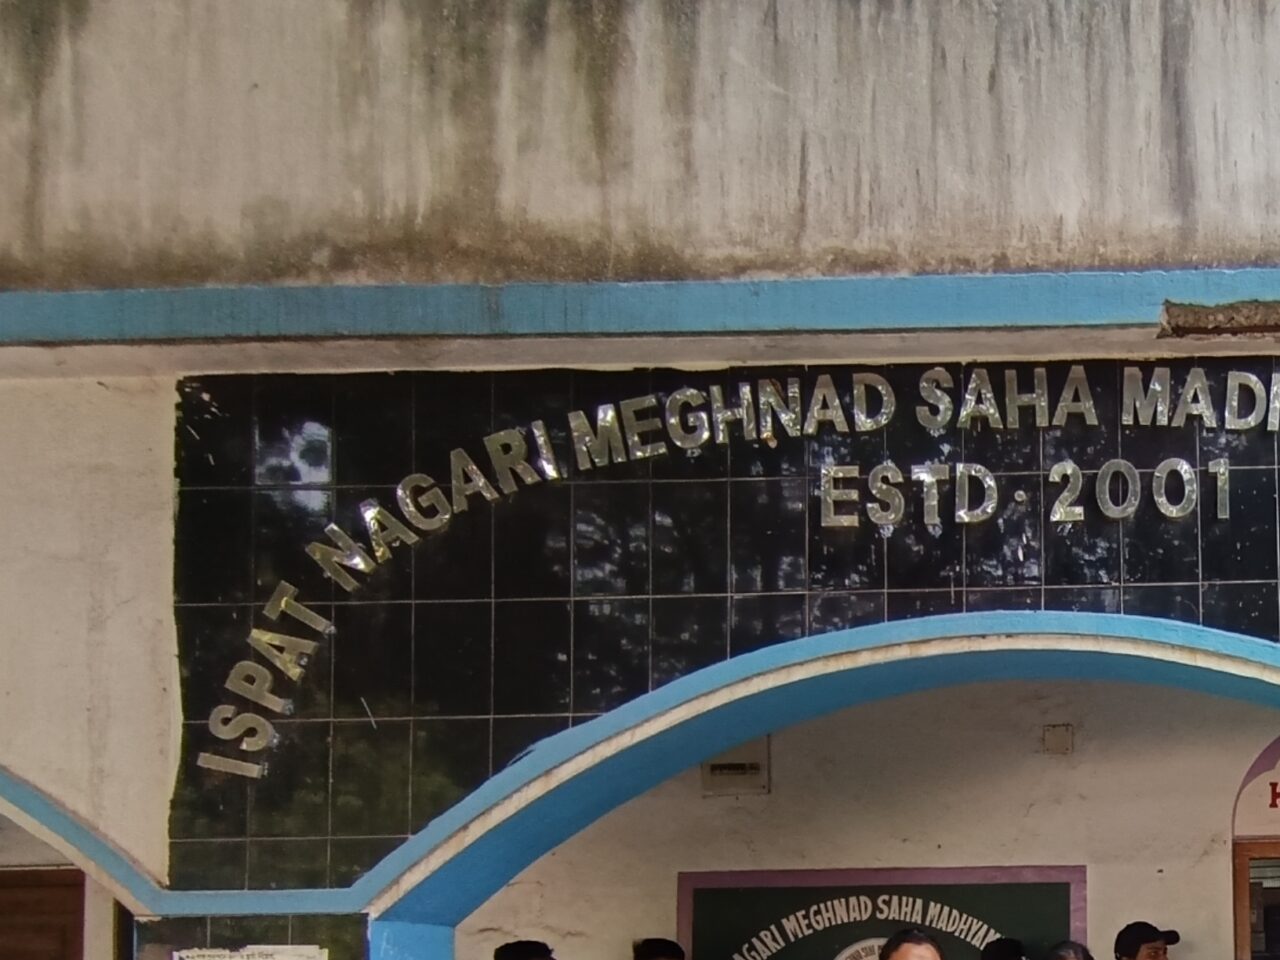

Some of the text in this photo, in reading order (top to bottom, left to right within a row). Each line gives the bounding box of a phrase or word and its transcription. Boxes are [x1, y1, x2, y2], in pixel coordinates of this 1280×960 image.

[1048, 457, 1230, 522] 2001
[197, 581, 336, 779] ISPAT
[306, 419, 560, 591] NAGARI
[567, 374, 896, 471] MEGHNAD
[917, 365, 1098, 428] SAHA
[781, 895, 872, 942] MEGHNAD
[876, 894, 922, 924] SAHA
[925, 901, 1002, 951] MADHYAM
